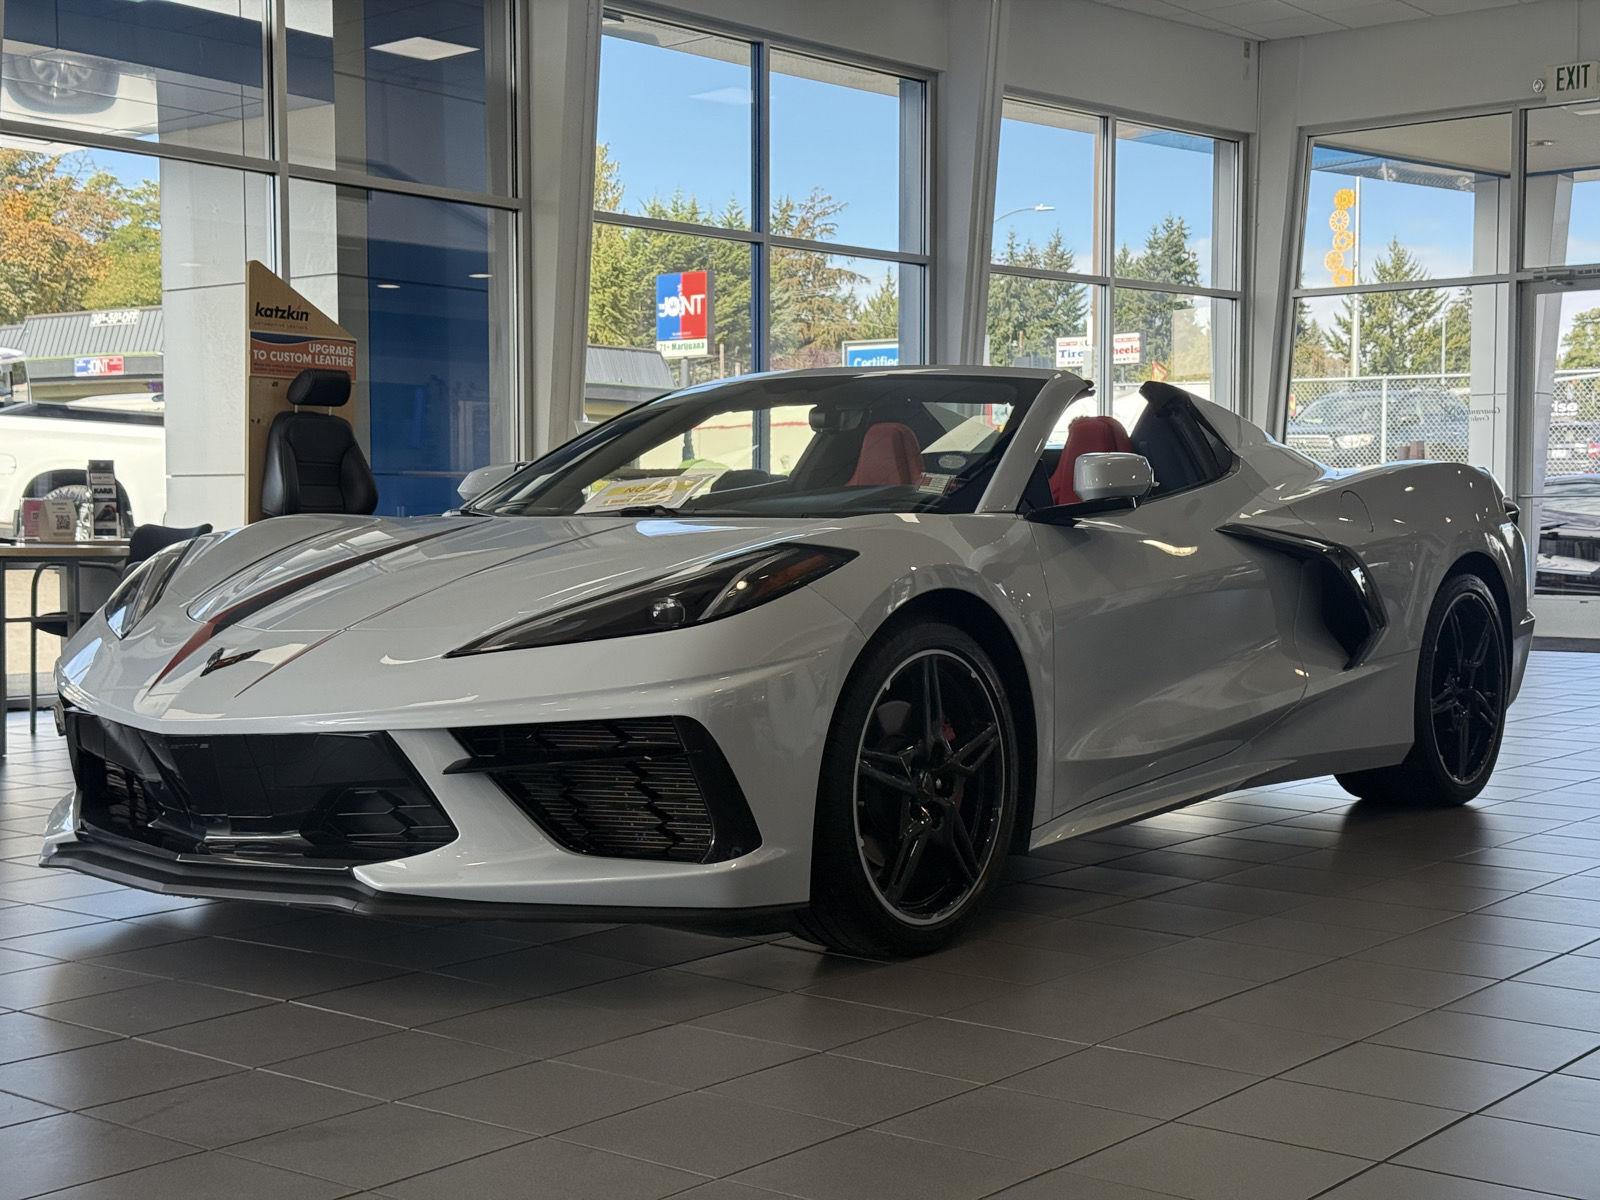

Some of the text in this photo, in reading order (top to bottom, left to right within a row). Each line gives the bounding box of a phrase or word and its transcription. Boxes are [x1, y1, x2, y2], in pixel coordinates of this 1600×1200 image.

[1556, 63, 1591, 92] EXIT
[255, 301, 309, 322] katzkin
[308, 343, 354, 357] UPGRADE
[671, 342, 705, 352] Marijuana
[1058, 349, 1083, 359] Tire
[253, 349, 267, 360] TO
[269, 351, 312, 364] CUSTOM
[315, 355, 354, 367] LEATHER
